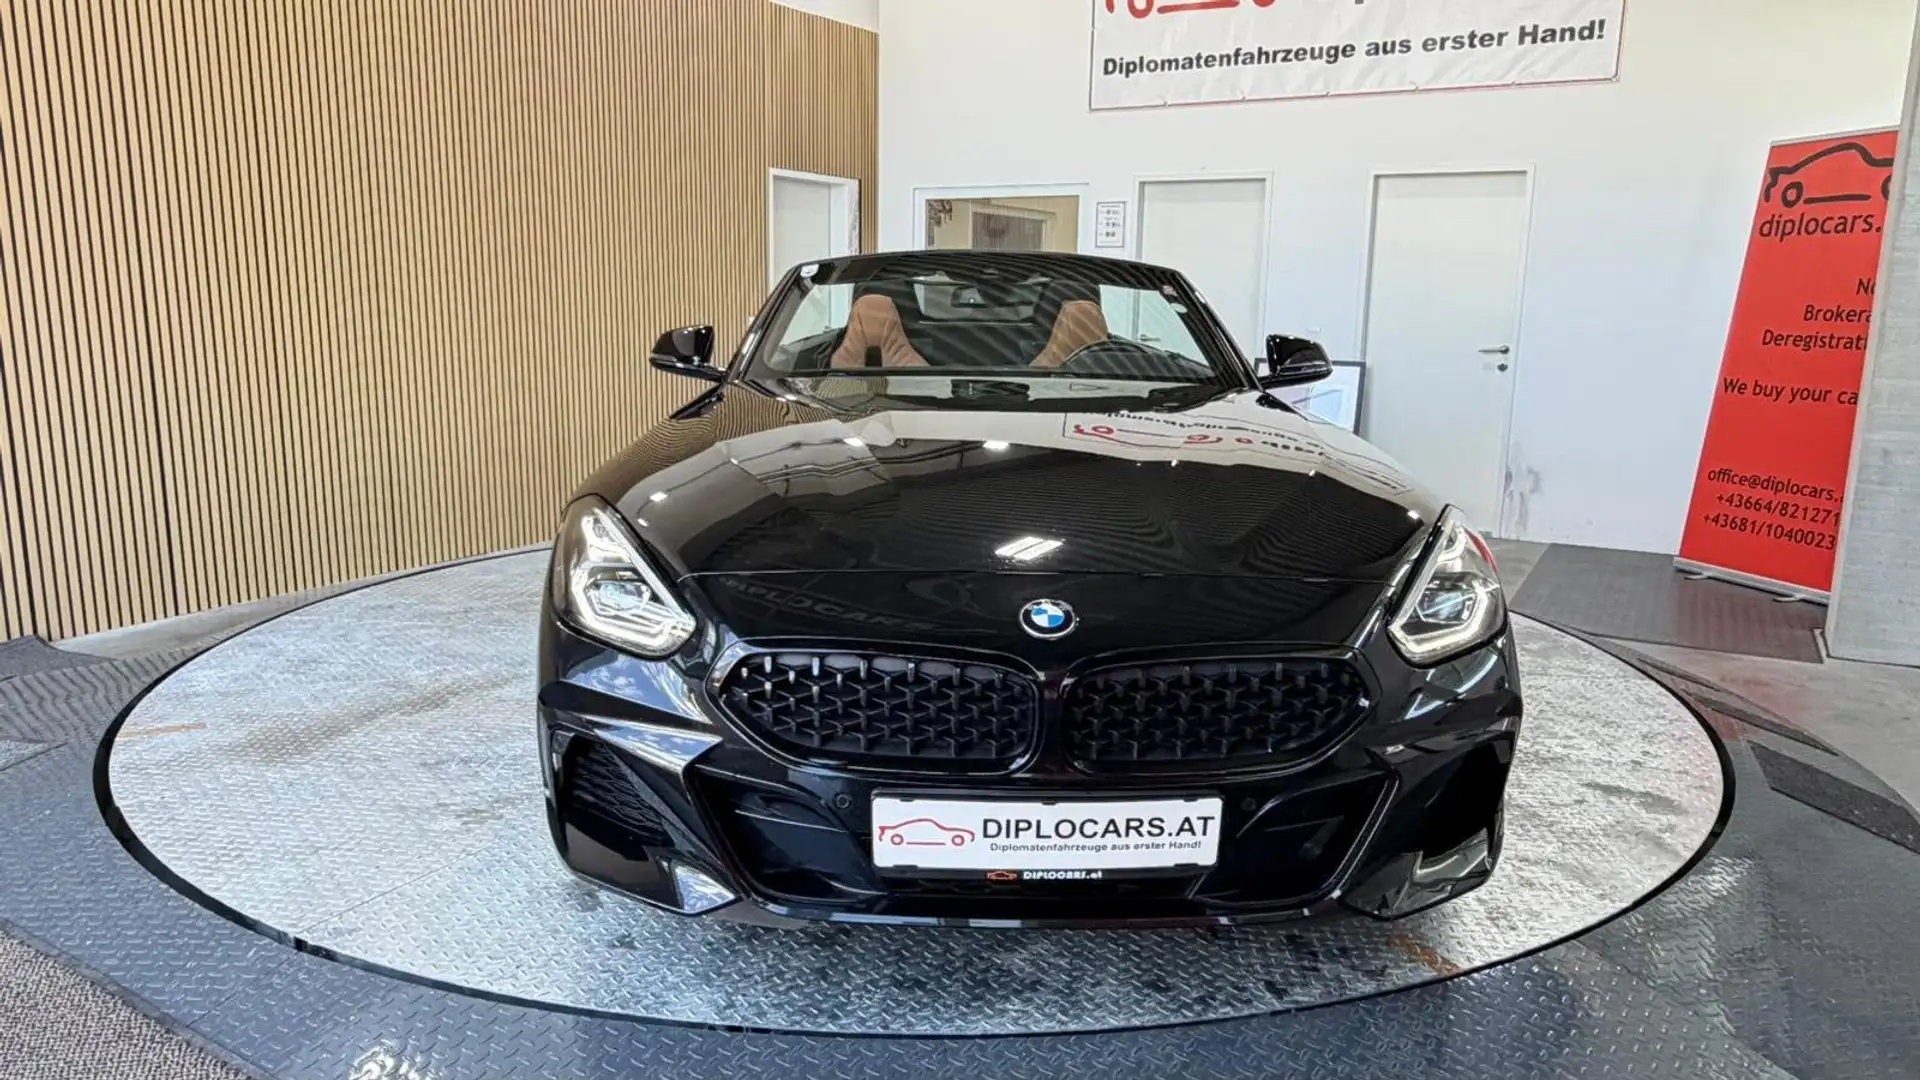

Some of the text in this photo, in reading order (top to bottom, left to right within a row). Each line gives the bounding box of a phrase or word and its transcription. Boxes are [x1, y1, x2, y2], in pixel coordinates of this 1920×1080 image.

[1103, 18, 1607, 78] Diplomatenfahrzeuge aus erster Hand!
[1722, 377, 1748, 395] We
[1752, 380, 1785, 402] buy
[1788, 387, 1833, 405] your
[1707, 468, 1844, 503] office@diplocars.
[1703, 513, 1836, 551] +43681/1040023
[982, 816, 1216, 839] DIPLOCARS.AT
[989, 840, 1202, 853] Diplomatenfahrzeuge aus erster Hand!
